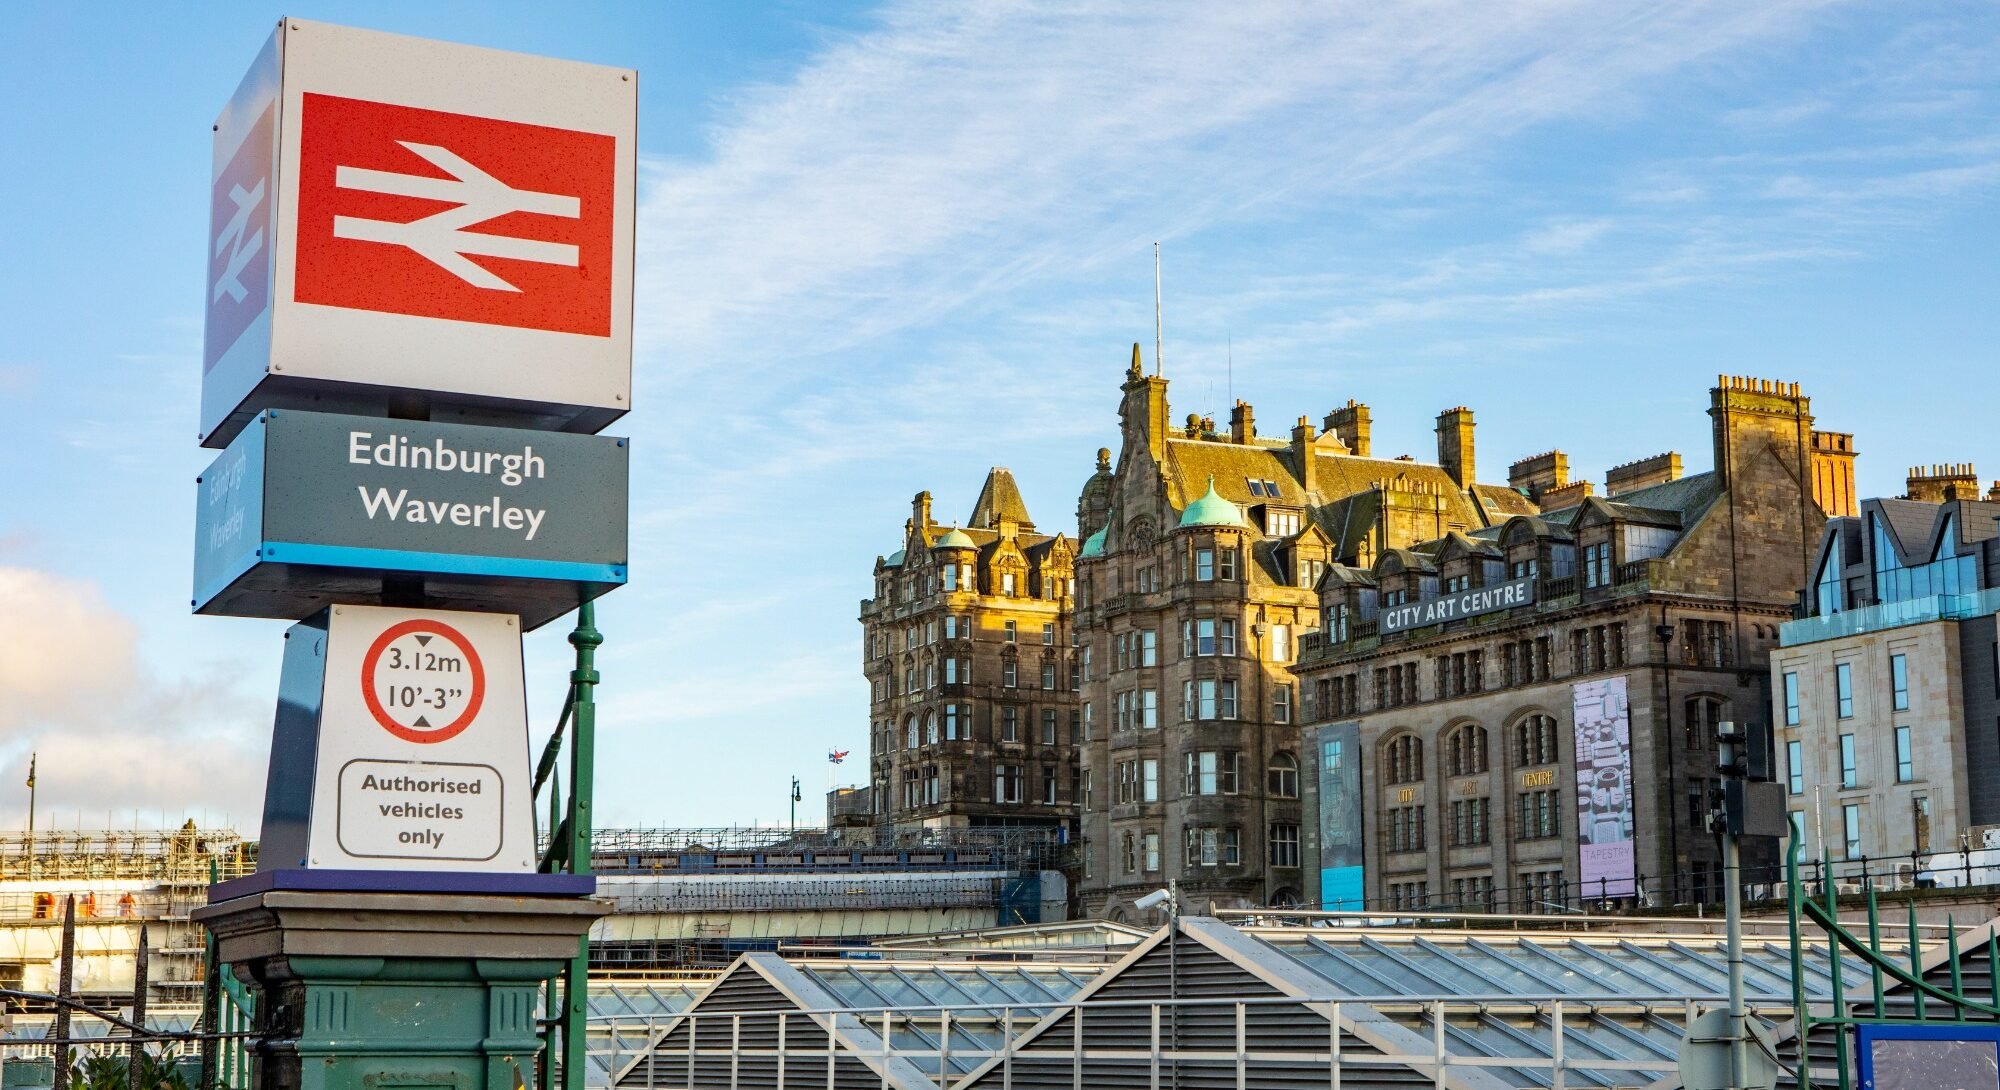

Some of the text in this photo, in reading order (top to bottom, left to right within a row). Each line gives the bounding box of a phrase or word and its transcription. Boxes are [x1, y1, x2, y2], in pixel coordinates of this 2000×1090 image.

[349, 431, 546, 487] Edinburgh
[210, 446, 247, 507] Edinburgh
[210, 506, 246, 553] Waverley
[358, 485, 546, 541] Waverley
[1386, 582, 1525, 629] CITY ART CENTRE
[389, 647, 461, 673] 3.12m
[361, 774, 482, 795] Authorised
[1398, 770, 1553, 803] CITY ART CENTRE
[379, 802, 463, 820] vehicles
[398, 828, 445, 849] only
[1584, 847, 1630, 860] TAPESTRY
